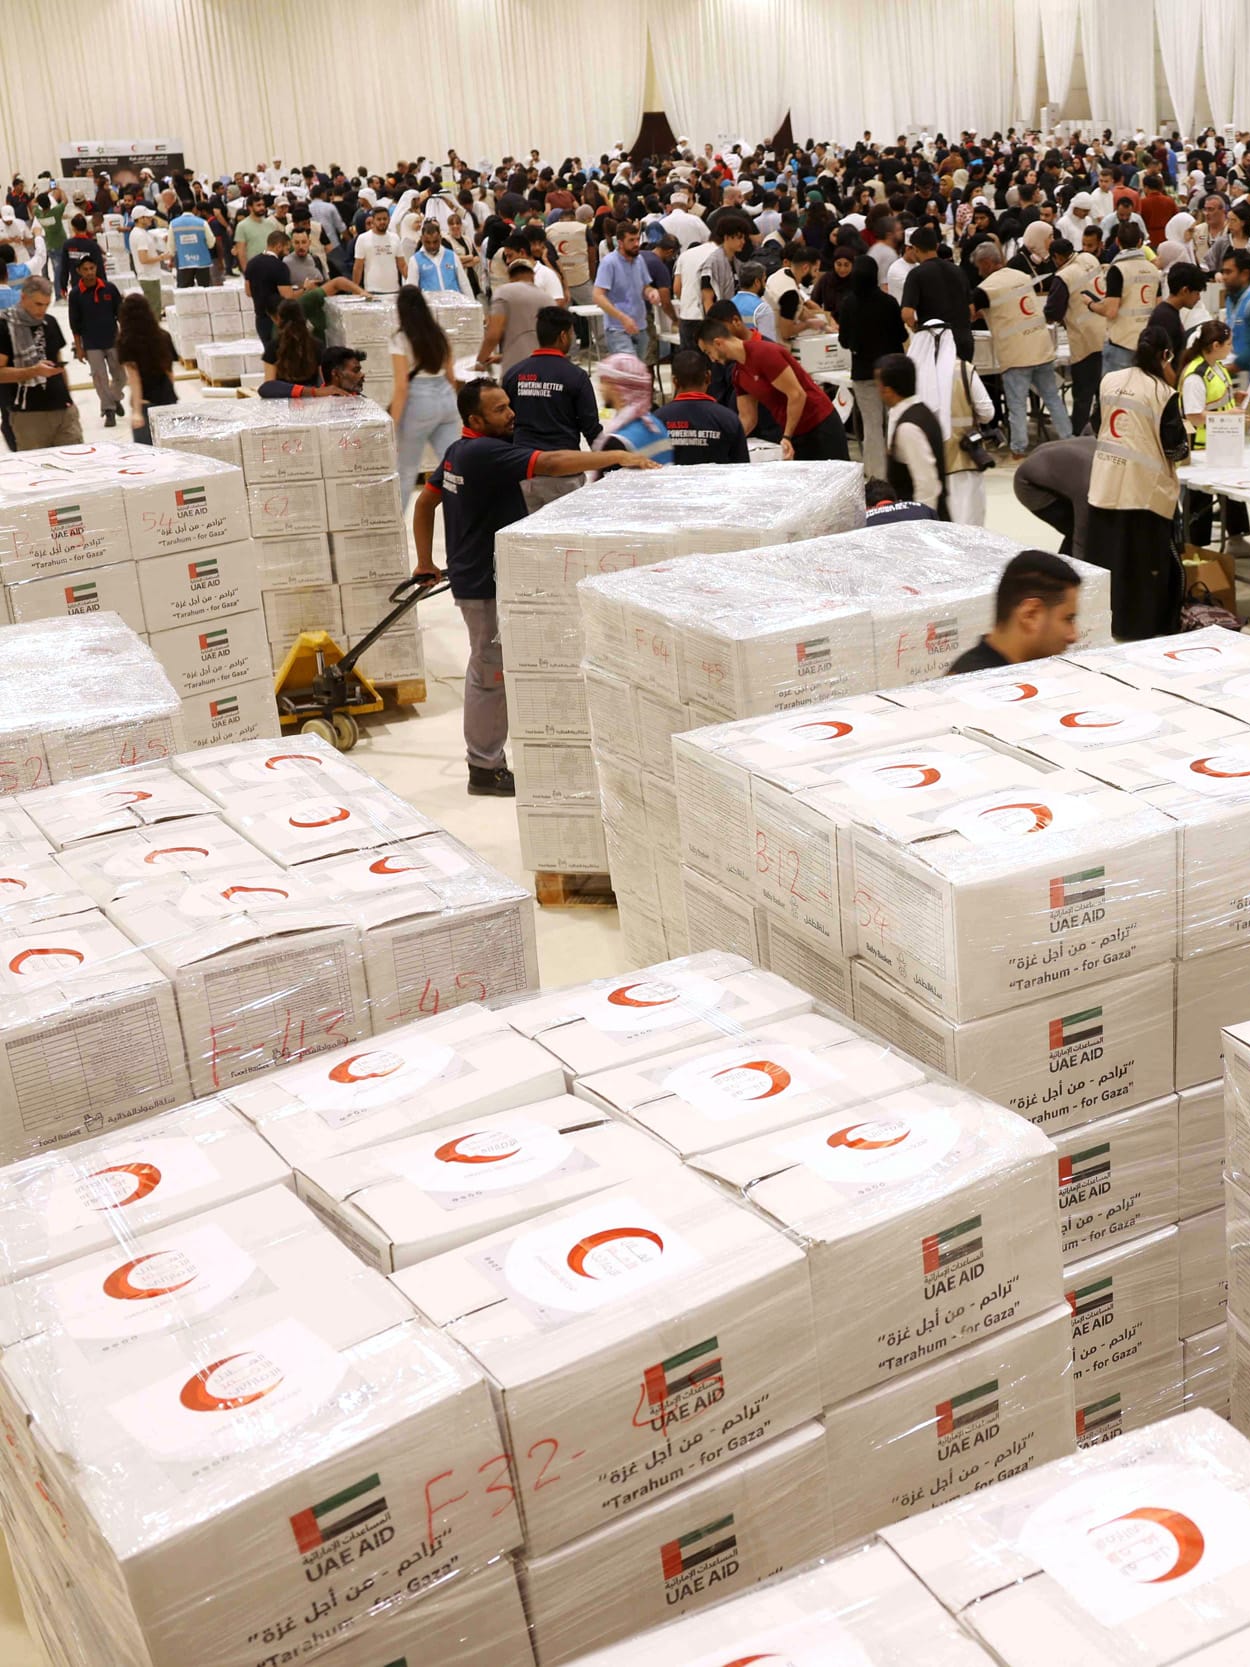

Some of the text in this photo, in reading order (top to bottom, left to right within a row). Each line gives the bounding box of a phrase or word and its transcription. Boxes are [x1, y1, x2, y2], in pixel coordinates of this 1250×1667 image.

[177, 507, 208, 518] UAE AID
[51, 527, 84, 539] UAE AID
[190, 579, 220, 591] UAE AID
[201, 649, 230, 662] UAE AID
[756, 831, 808, 902] B-12
[1050, 907, 1105, 934] UAE AID
[1043, 940, 1086, 964] من أجل
[1082, 959, 1099, 972] for
[1050, 1048, 1103, 1073] UAE AID
[1042, 1080, 1063, 1103] أجل
[1067, 1080, 1085, 1096] من
[1081, 1096, 1099, 1109] for
[1059, 1181, 1111, 1210] UAE AID
[1076, 1215, 1094, 1229] من
[1089, 1226, 1106, 1241] for
[924, 1263, 984, 1300] UAE AID
[916, 1309, 940, 1337] أجل
[945, 1305, 965, 1324] من
[1072, 1313, 1114, 1339] AE AID
[960, 1322, 981, 1337] for
[1080, 1345, 1097, 1360] من
[1093, 1357, 1109, 1372] for
[650, 1387, 726, 1432] UAE AID
[680, 1431, 703, 1454] من
[937, 1424, 1000, 1462] UAE AID
[645, 1439, 672, 1470] أجل
[700, 1448, 723, 1466] for
[930, 1464, 979, 1496] من أجل
[305, 1526, 396, 1583] UAE AID
[666, 1560, 740, 1606] UAE AID
[304, 1576, 376, 1623] من أجل
